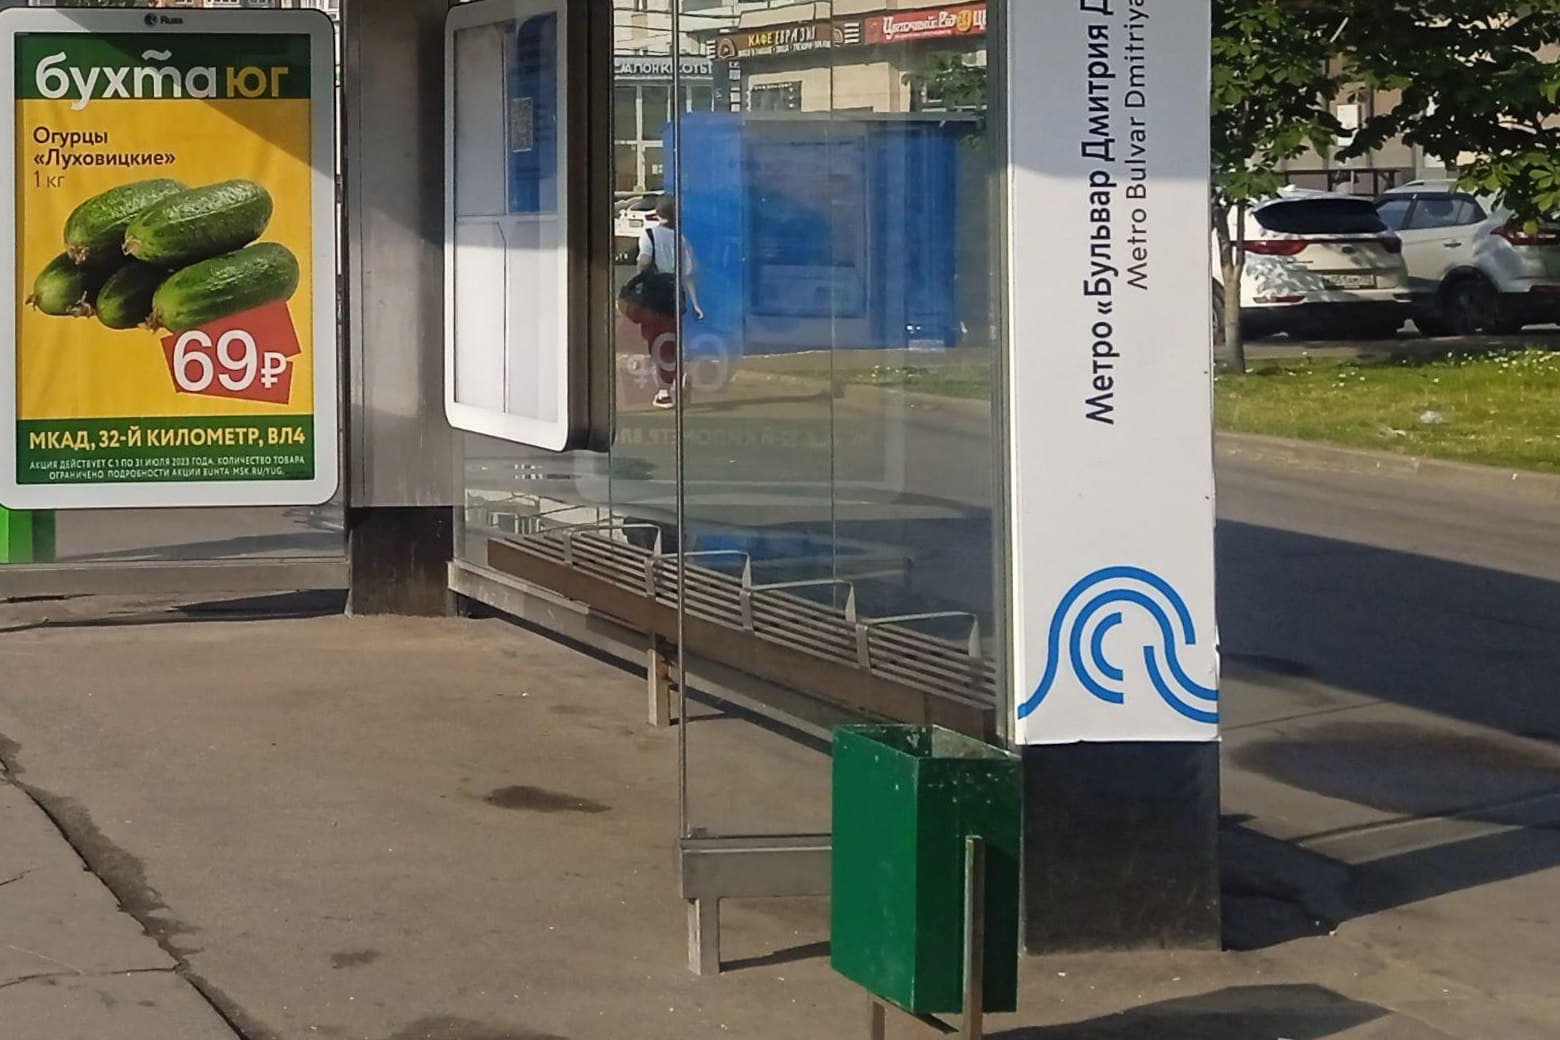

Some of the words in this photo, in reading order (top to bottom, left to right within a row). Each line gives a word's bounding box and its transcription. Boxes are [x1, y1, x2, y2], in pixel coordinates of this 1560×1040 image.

[748, 32, 773, 47] КАФЕ
[226, 66, 288, 98] юг
[1081, 25, 1116, 162] Дмитрия
[33, 126, 108, 147] Огурцы
[33, 149, 176, 170] «Луховицкие»
[1126, 121, 1147, 200] Bulvar
[34, 171, 41, 188] 1
[46, 174, 65, 188] кг
[1083, 170, 1119, 316] «Бульвар
[1127, 208, 1148, 290] Metro
[1085, 320, 1121, 426] Метро
[29, 431, 96, 451] МКАД,
[98, 425, 141, 448] 32-Й
[147, 427, 264, 448] КИЛОМЕТР,
[268, 427, 306, 445] ВЛ4
[30, 460, 58, 470] АКЦИЯ
[60, 458, 106, 470] ДЕЙСТВУЕТ
[115, 458, 119, 467] 1
[121, 458, 133, 467] ПО
[145, 457, 169, 466] ИЮЛЯ
[218, 456, 271, 465] КОЛИЧЕСТВО
[273, 455, 305, 465] ТОВАРА
[107, 468, 169, 478] ПОДРОБНОСТИ
[172, 468, 200, 477] АКЦИИ
